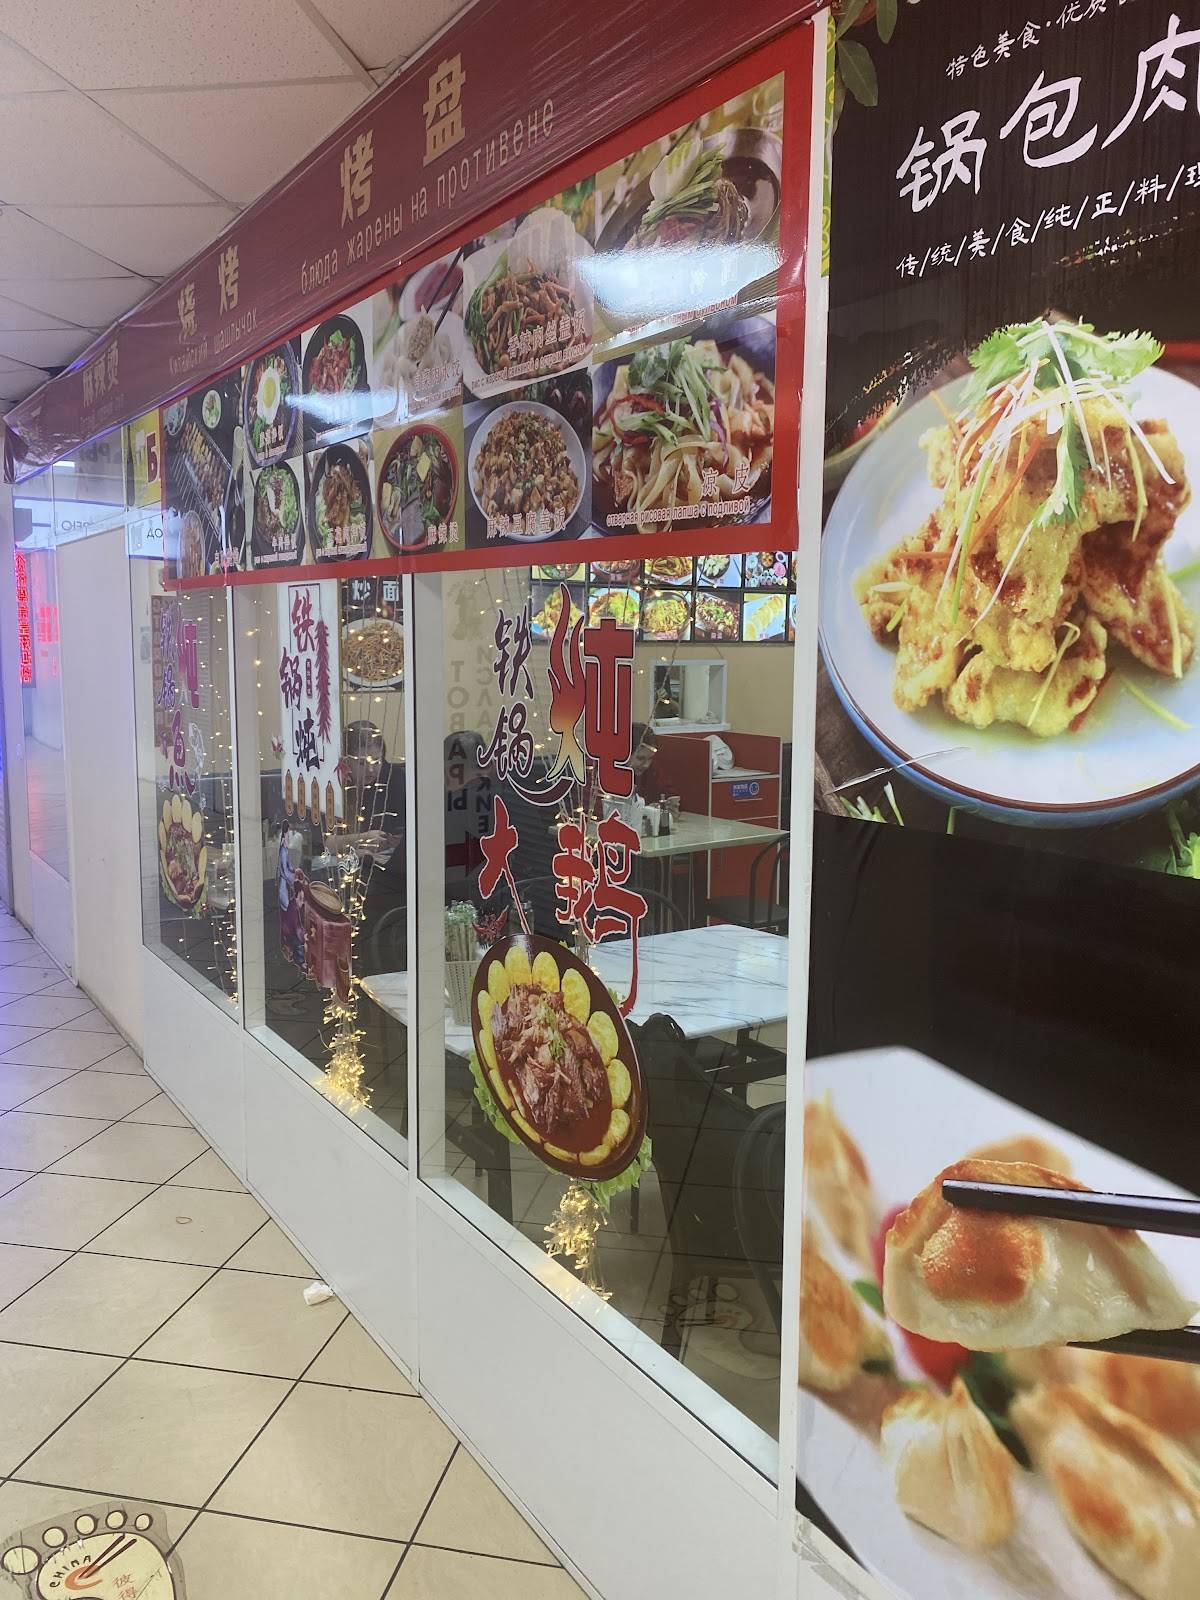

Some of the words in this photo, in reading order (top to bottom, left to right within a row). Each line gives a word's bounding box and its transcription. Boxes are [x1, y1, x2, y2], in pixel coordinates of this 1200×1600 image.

[946, 0, 1127, 80] 特色美食·优质
[340, 53, 466, 229] 烤盘
[896, 13, 1200, 213] 锅包肉
[301, 254, 338, 296] блюда
[347, 212, 403, 269] жарены
[411, 191, 428, 225] на
[437, 98, 554, 207] противене
[178, 245, 240, 340] 烧烤
[607, 512, 639, 528] отварная
[640, 509, 671, 526] рисовая
[673, 505, 698, 520] лапша
[699, 504, 707, 517] с
[707, 496, 751, 518] подливой
[702, 464, 750, 495] 凉皮
[351, 579, 400, 602] 炒面
